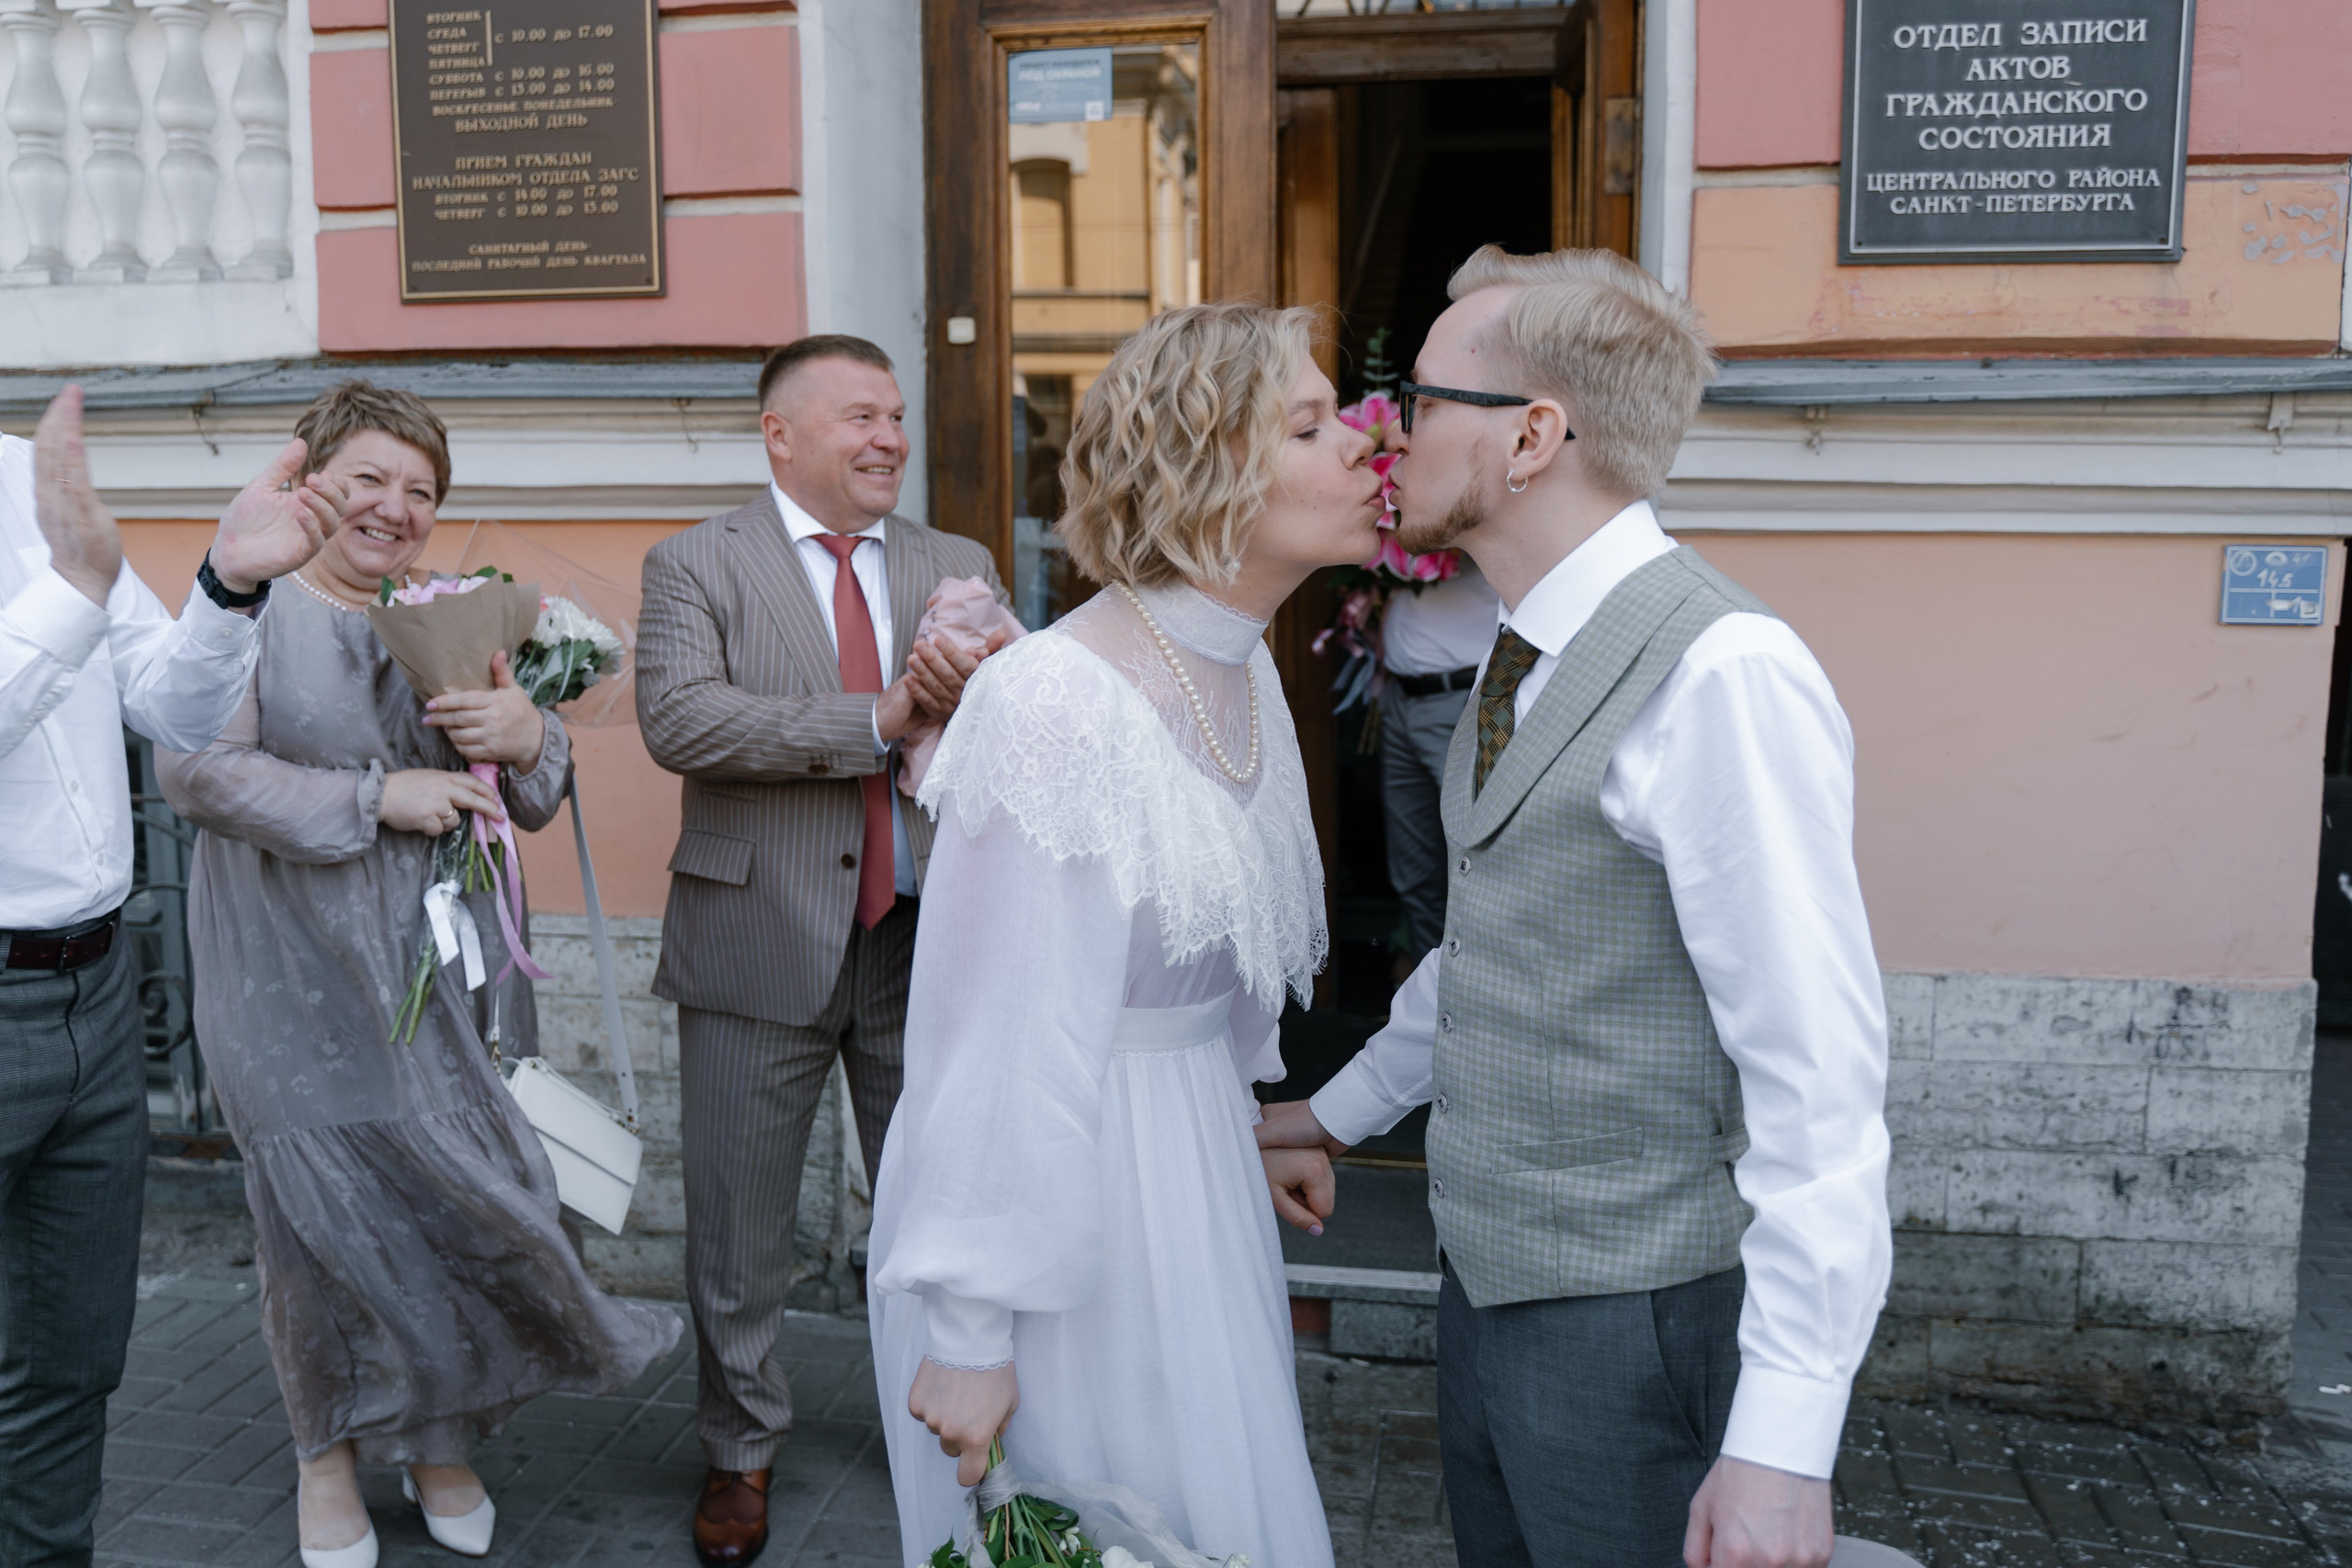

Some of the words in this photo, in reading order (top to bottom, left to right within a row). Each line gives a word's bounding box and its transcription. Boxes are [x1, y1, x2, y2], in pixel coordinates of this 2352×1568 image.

[426, 10, 481, 24] ВТОРНИК
[426, 27, 467, 40] СРЕДА
[511, 28, 546, 42] 10.00
[579, 24, 614, 39] 17.00
[1893, 24, 2003, 51] ОТДЕЛ
[2020, 18, 2148, 46] ЗАПИСИ
[427, 41, 481, 55] ЧЕТВЕРГ
[428, 56, 485, 70] ПЯТНИЦА
[1965, 56, 2071, 83] АКТОВ
[428, 72, 484, 85] СУББОТА
[511, 66, 546, 81] 10.00
[1018, 70, 1046, 83] ПОД
[429, 86, 486, 101] ПЕРЕРЫВ
[579, 77, 616, 94] 14.00
[1885, 88, 2149, 119] ГРАЖДАНСКОГО
[456, 112, 538, 134] ВЫХОДНОЙ
[546, 113, 588, 130] ДЕНЬ
[1917, 124, 2111, 151] СОСТОЯНИЯ
[456, 154, 507, 171] ПРИЕМ
[515, 151, 592, 167] ГРАЖДАН
[412, 173, 522, 191] НАЧАЛЬНИКОМ
[529, 169, 592, 186] ОТДЕЛА
[597, 167, 639, 182] ЗАГС
[1866, 171, 2056, 195] ЦЕНТРАЛЬНОГО
[2067, 166, 2161, 189] РАЙОНА
[435, 191, 489, 206] ВТОРНИК
[515, 186, 548, 202] 14.00
[583, 184, 617, 199] 17.00
[1889, 193, 2135, 215] САНКТ-ПЕТЕРБУРГА
[434, 208, 486, 221] ЧЕТВЕРГ
[515, 203, 548, 218] 10.00
[469, 239, 549, 255] САНИТАРНЫЙ
[412, 257, 481, 273] ПОСЛЕДНИЙ
[487, 254, 540, 270] РАБОЧИЙ
[546, 255, 579, 270] ДЕНЬ
[584, 253, 647, 266] КВАРТАЛА
